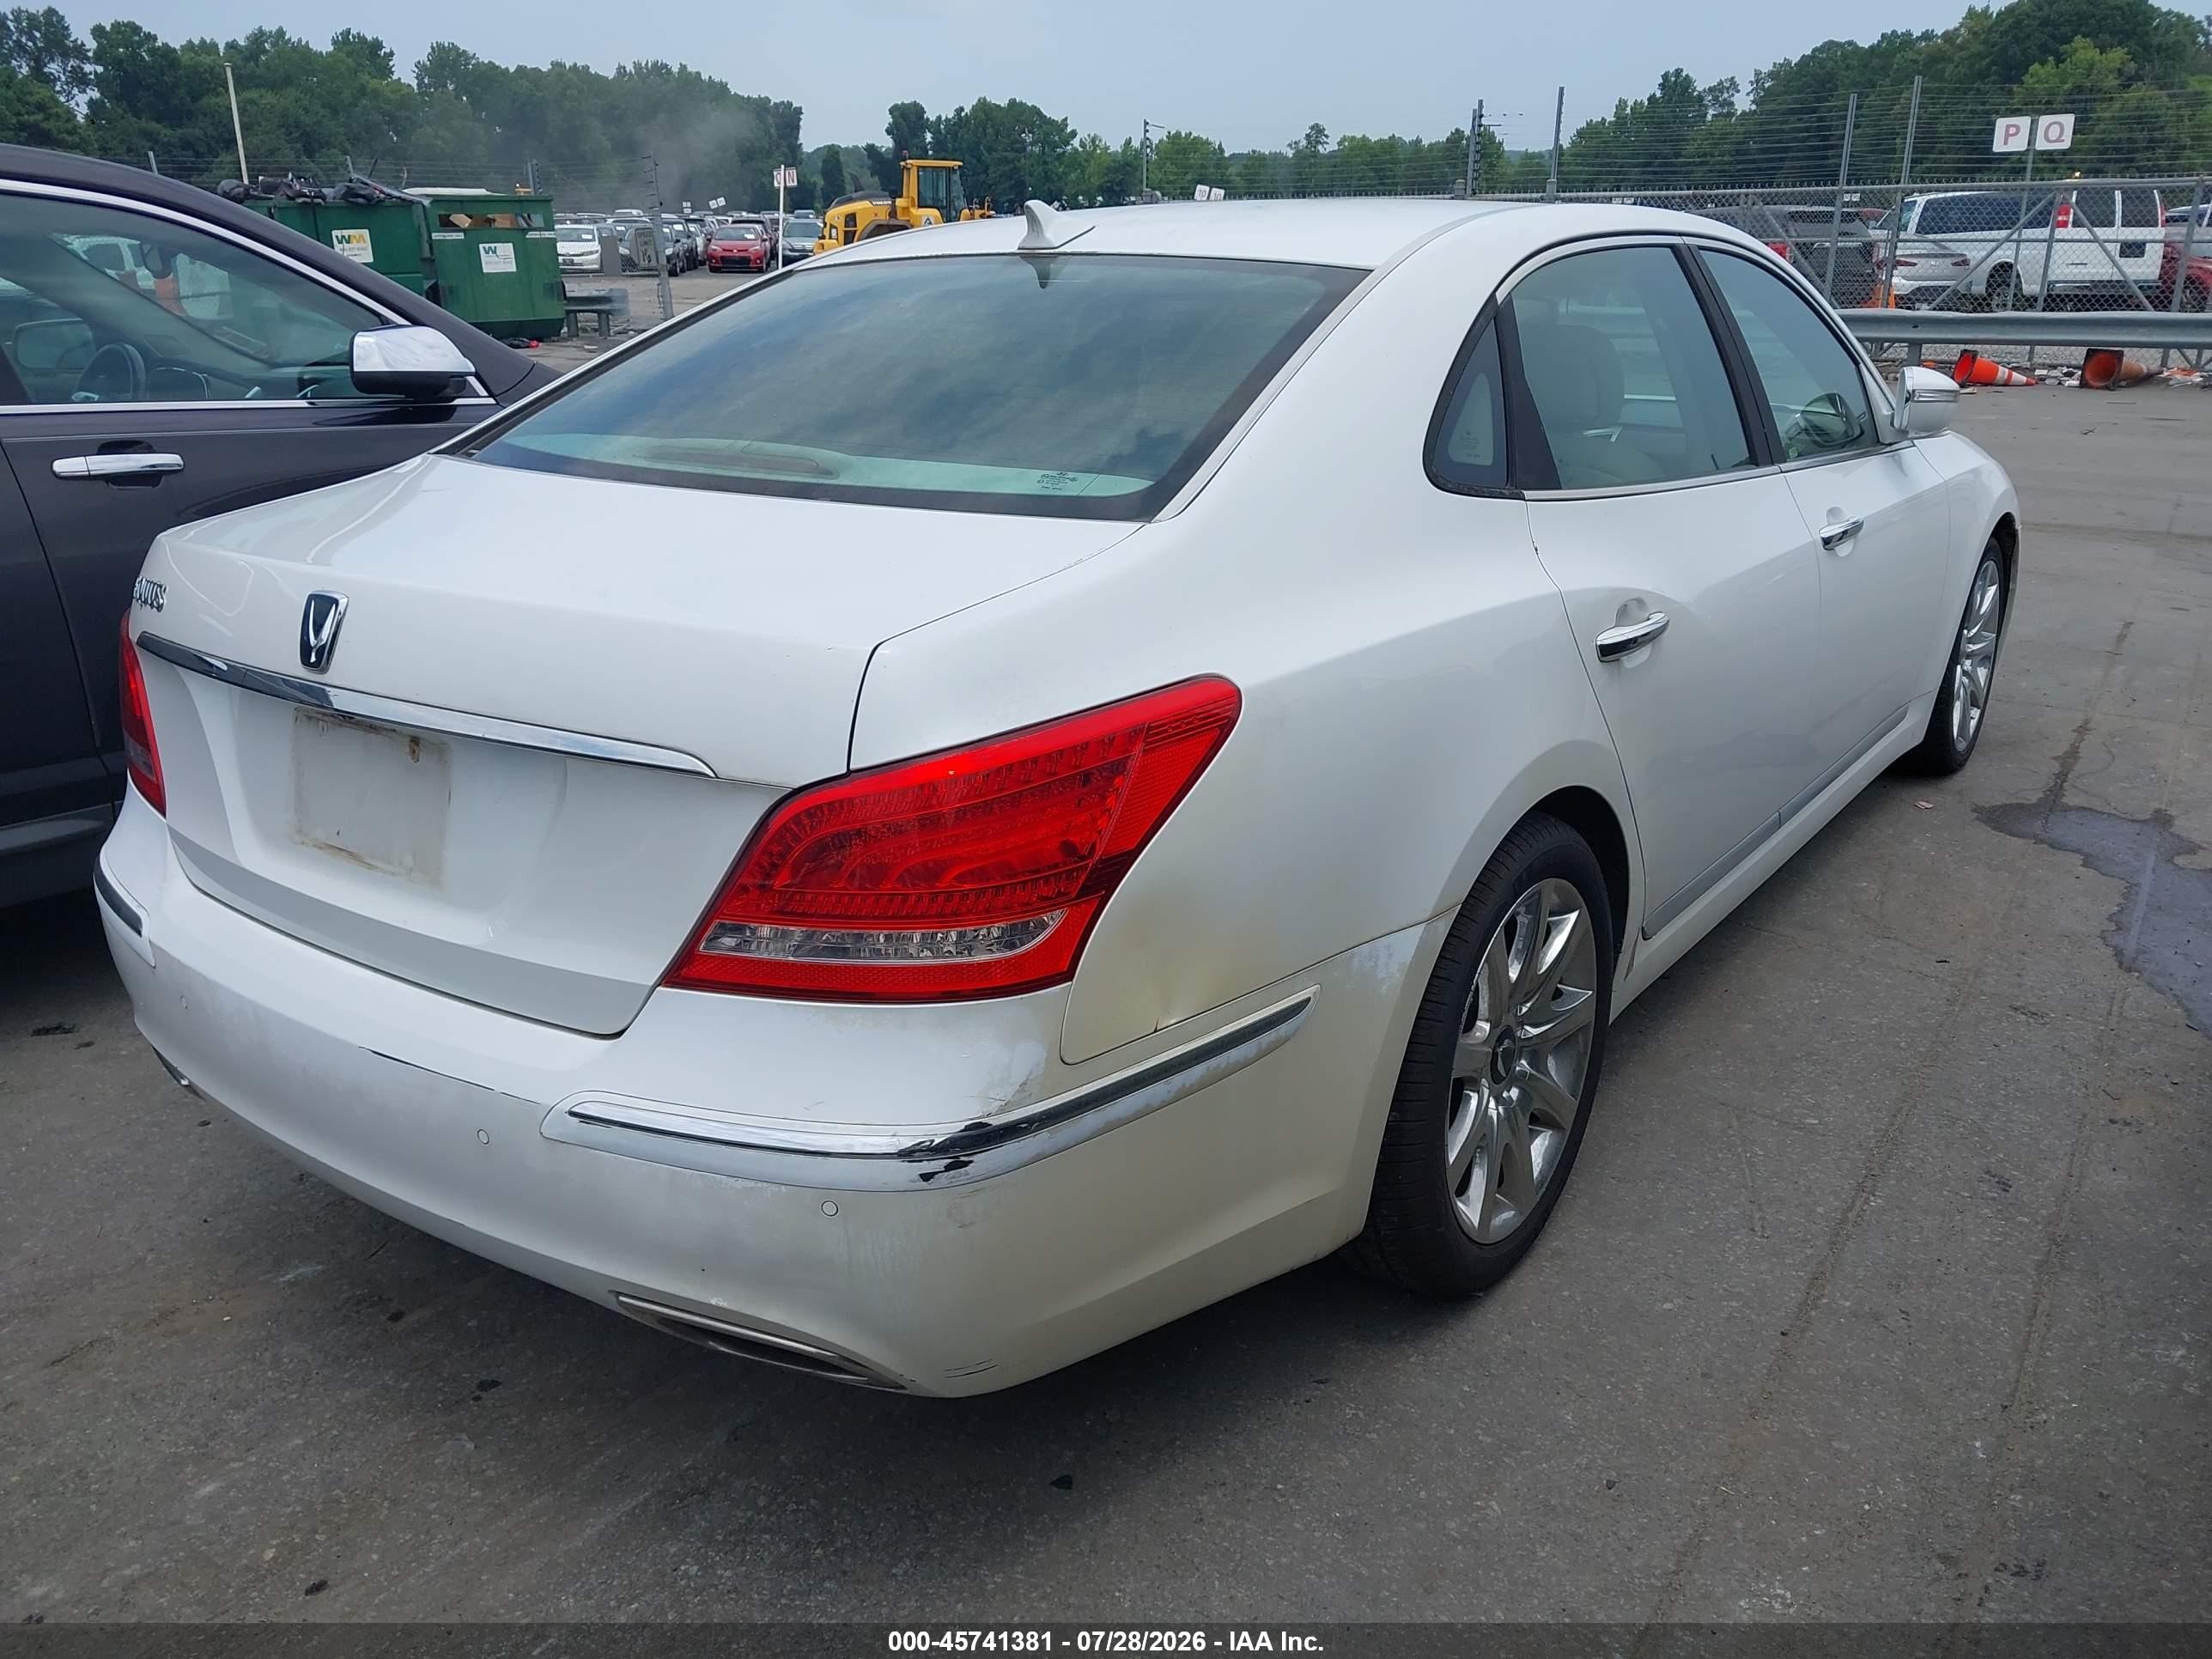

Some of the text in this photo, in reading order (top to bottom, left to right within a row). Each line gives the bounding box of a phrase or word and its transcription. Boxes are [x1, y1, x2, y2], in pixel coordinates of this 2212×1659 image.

[2003, 121, 2065, 146] P Q
[787, 171, 795, 184] N
[335, 234, 366, 244] WM
[133, 576, 168, 612] EQUUS
